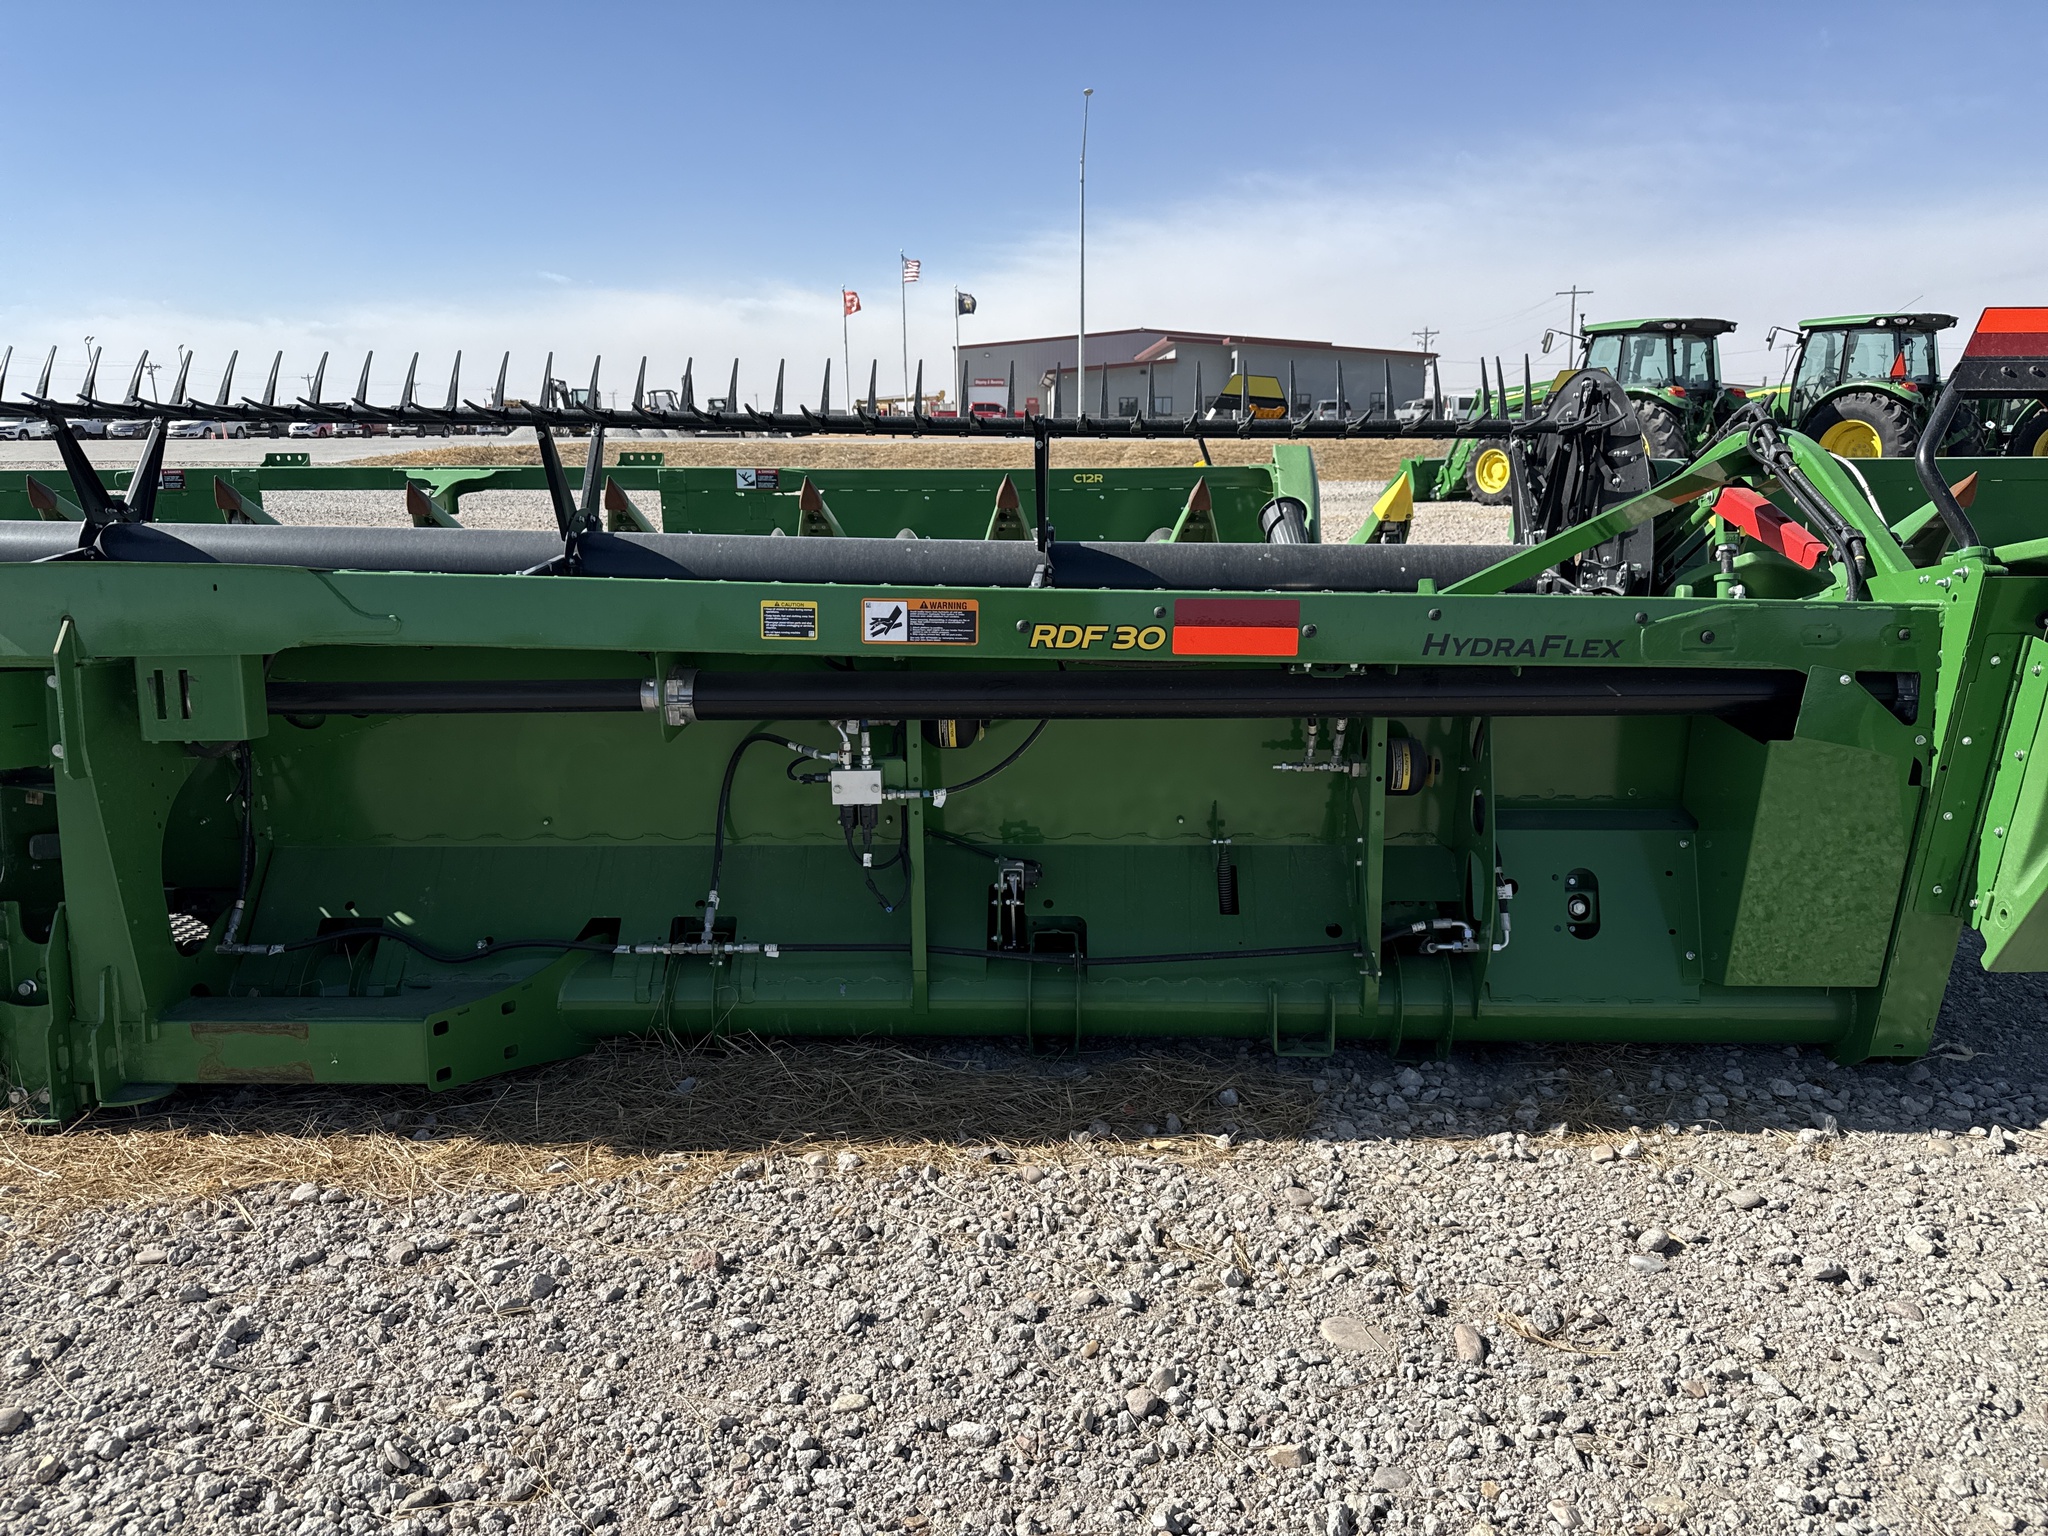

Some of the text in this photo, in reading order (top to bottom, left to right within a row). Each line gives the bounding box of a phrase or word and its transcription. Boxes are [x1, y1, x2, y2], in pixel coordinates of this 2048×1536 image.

[1073, 474, 1104, 483] C12R
[929, 602, 968, 610] WARNING
[1028, 624, 1167, 650] RDF 30
